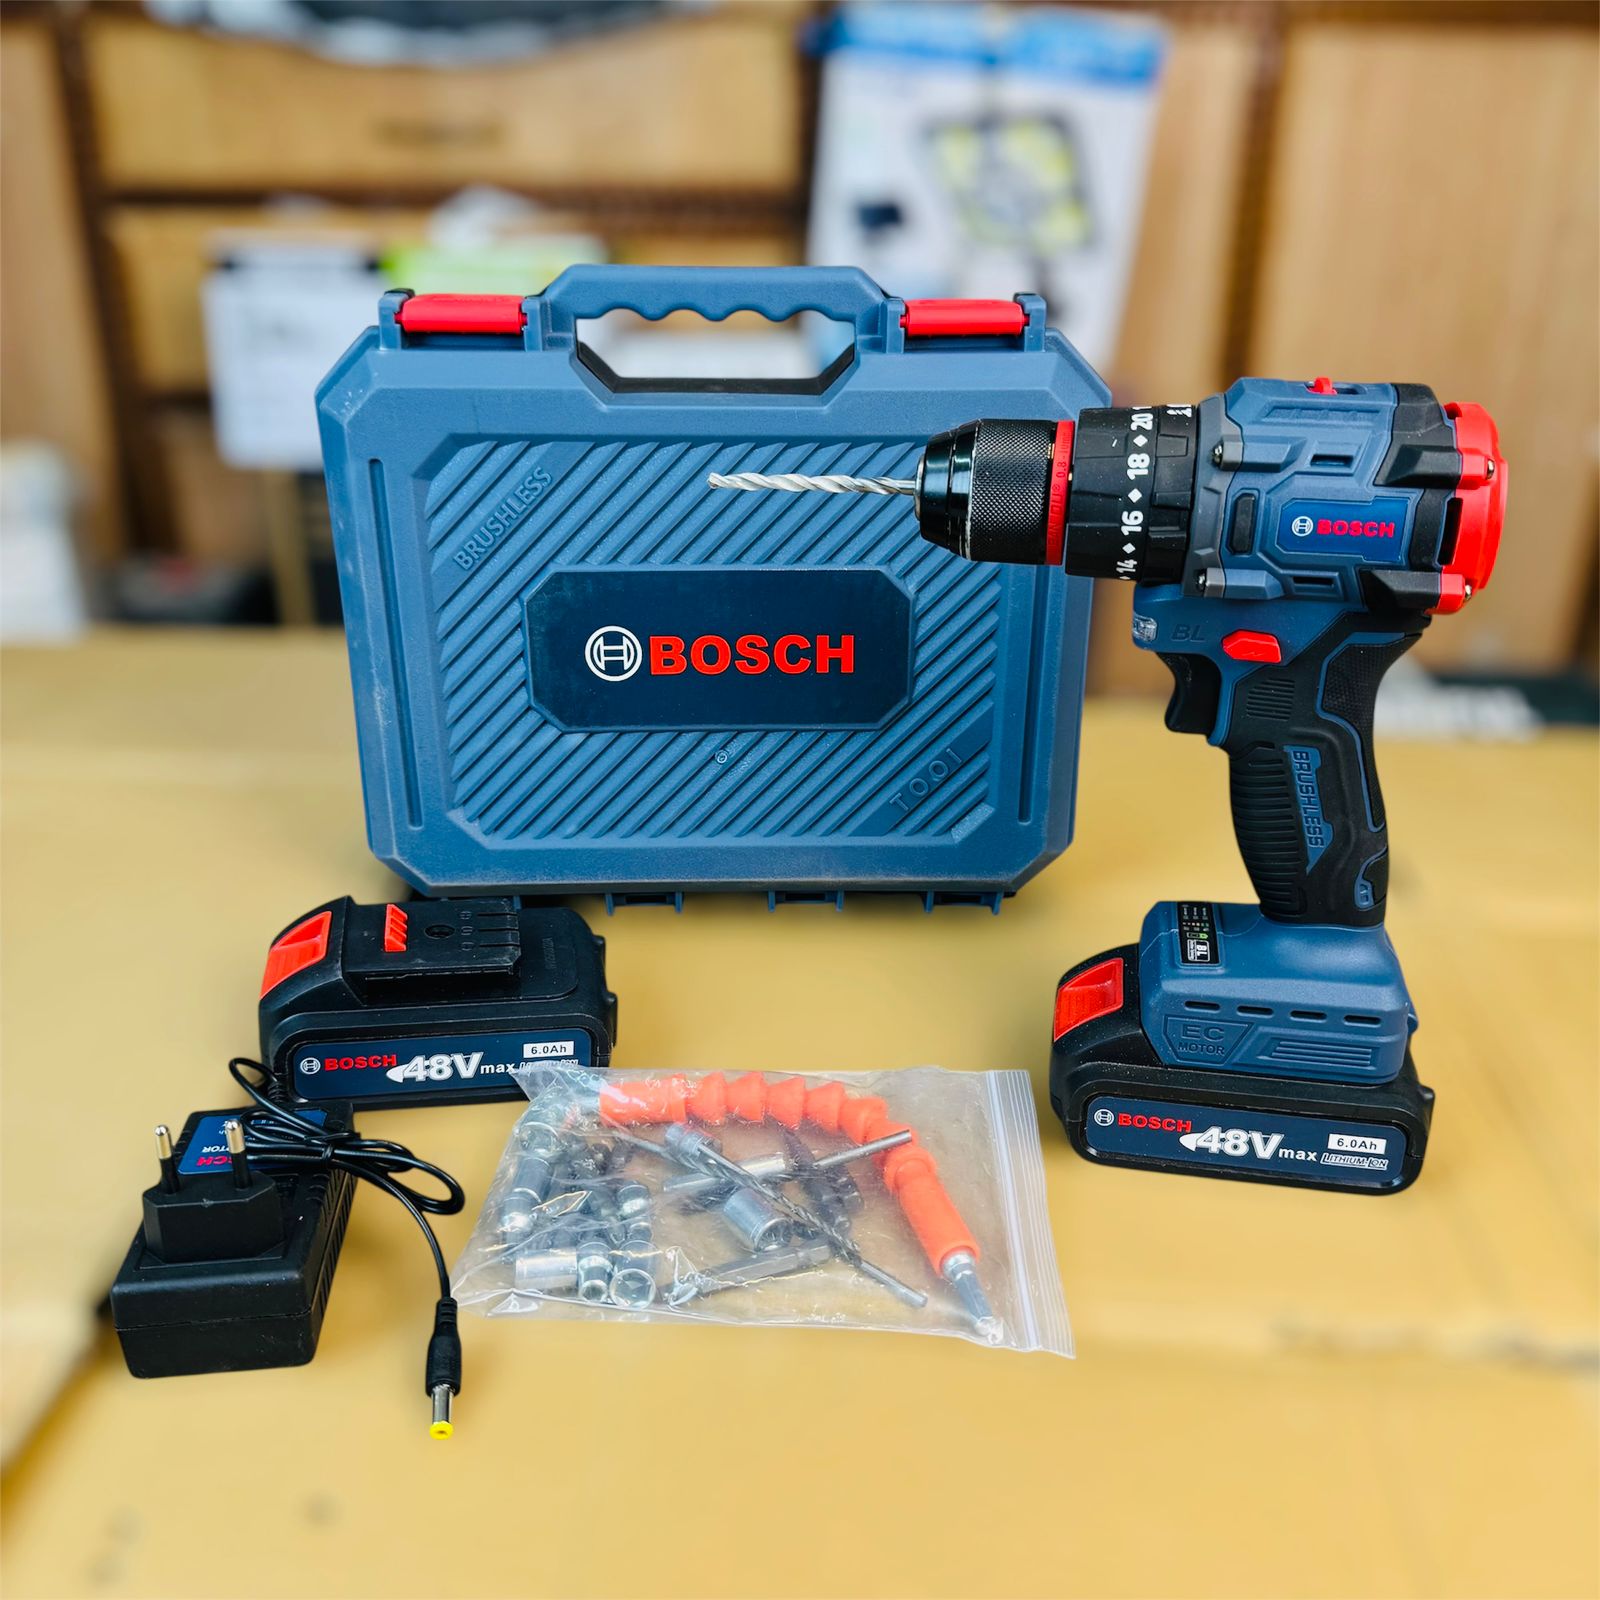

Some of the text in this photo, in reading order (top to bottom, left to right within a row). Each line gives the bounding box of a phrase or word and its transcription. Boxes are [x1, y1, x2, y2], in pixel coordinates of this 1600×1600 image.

[1131, 412, 1153, 430] 20
[1127, 452, 1150, 480] 18
[453, 467, 552, 570] BRUSHLESS
[1121, 510, 1144, 536] 16
[1317, 518, 1395, 538] BOSCH
[1116, 559, 1138, 573] 14
[1171, 623, 1206, 642] BL
[649, 634, 855, 676] BOSCH
[1293, 750, 1325, 848] BRUSHLESS
[1181, 1024, 1225, 1041] EC
[530, 1044, 567, 1055] 6.0Ah
[1178, 1041, 1225, 1056] MOTOR
[324, 1054, 397, 1071] BOSCH
[401, 1051, 485, 1083] 48V
[480, 1062, 516, 1075] max
[1117, 1113, 1318, 1162] BOSCH 48V max
[1336, 1137, 1378, 1151] 6.0Ah
[1320, 1153, 1389, 1171] LITHIUM-ION
